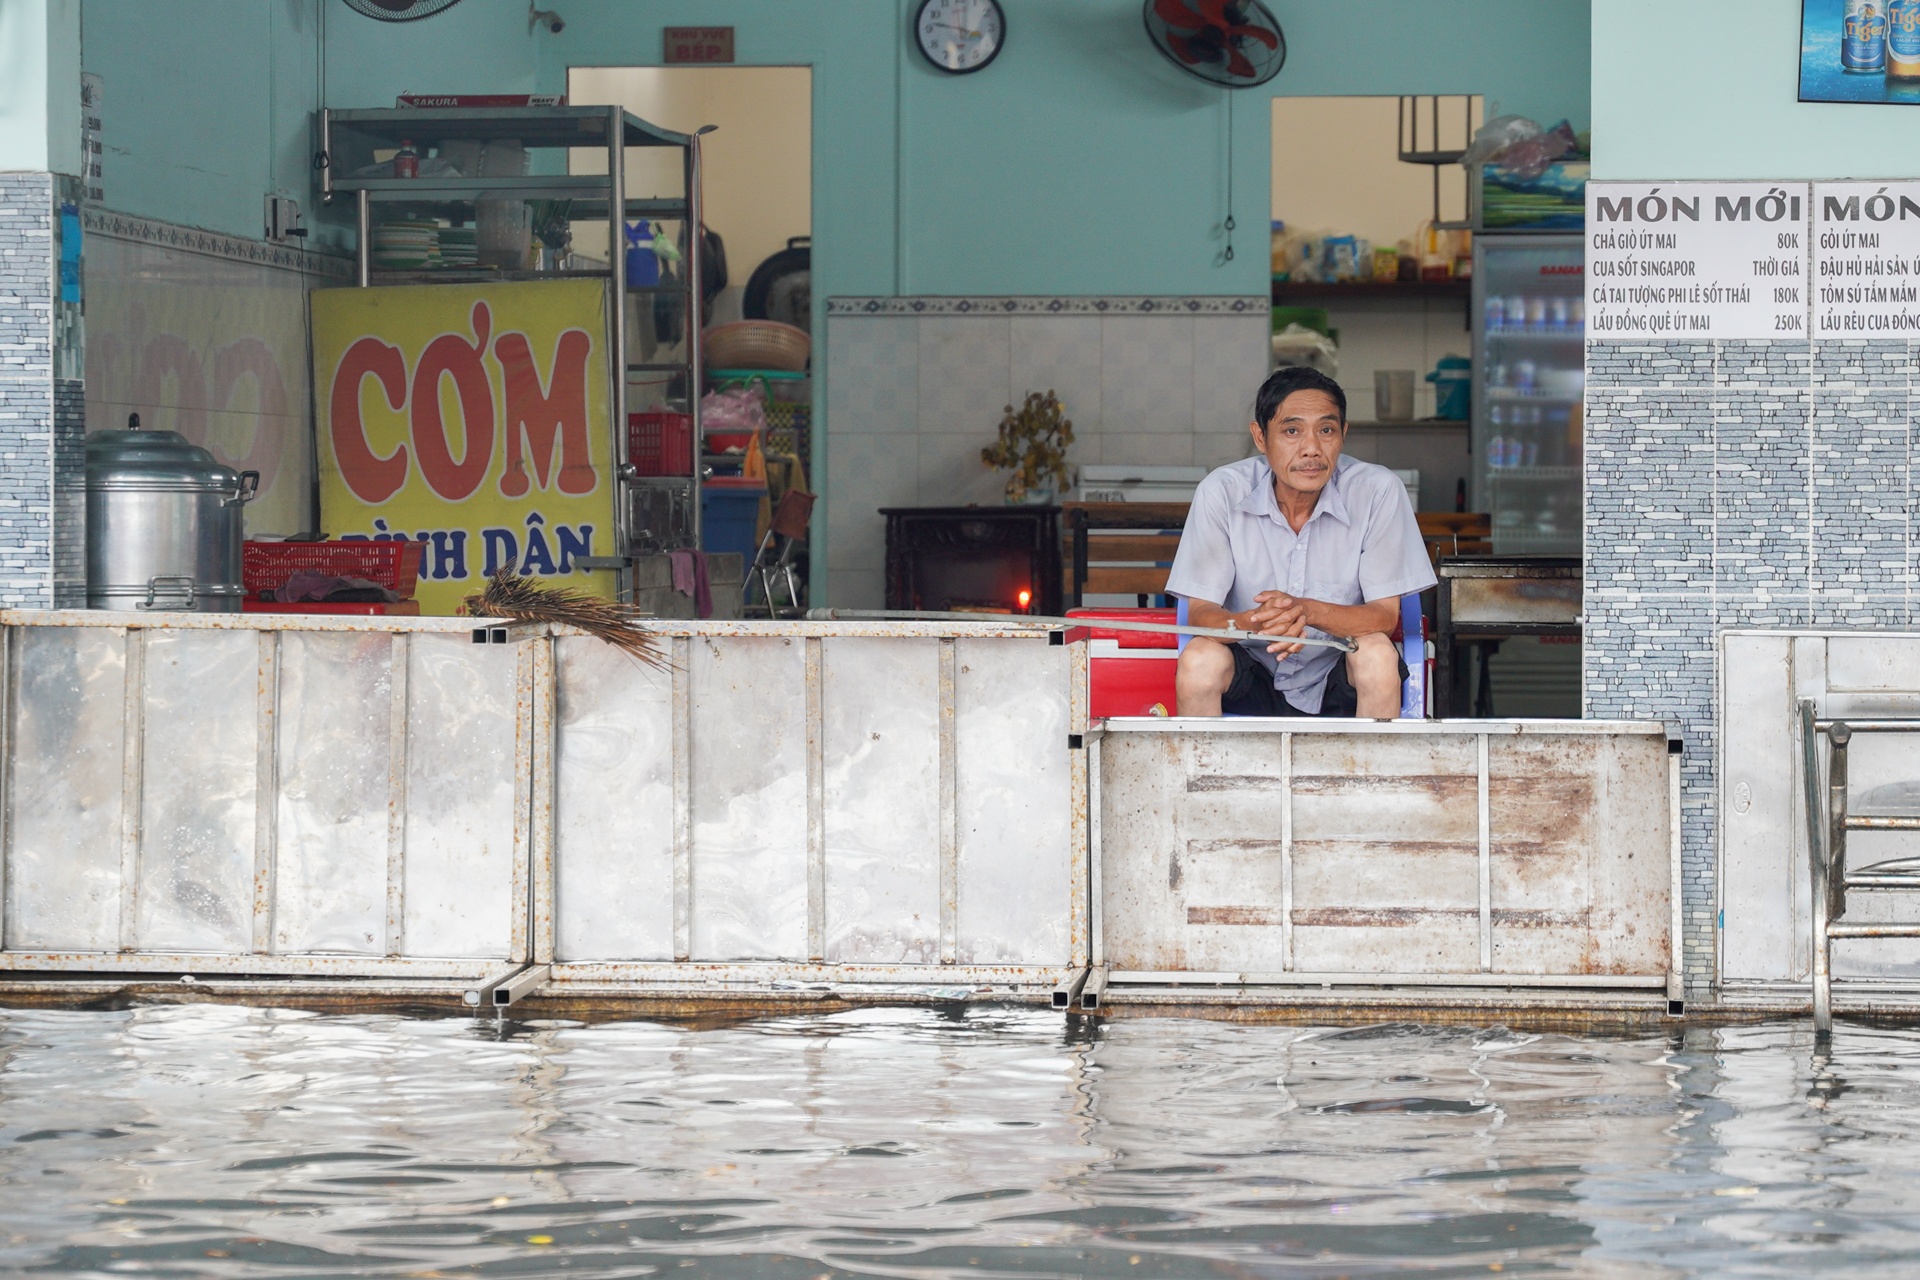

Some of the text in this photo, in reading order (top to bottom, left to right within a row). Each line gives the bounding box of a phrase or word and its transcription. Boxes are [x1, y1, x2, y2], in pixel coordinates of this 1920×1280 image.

[930, 10, 941, 19] 10
[1890, 8, 1920, 33] Tig
[925, 24, 933, 34] 9
[1847, 22, 1884, 42] Tiger
[413, 97, 458, 107] SAKURA
[1597, 188, 1800, 222] MÓN MỚI
[1824, 187, 1920, 222] MÓN
[1593, 228, 1799, 249] CHẢ GIÒ ÚT MAI 80K
[1821, 228, 1879, 249] GỎI ÚT MAI
[1593, 254, 1799, 276] CUA SỐT SINGAPOR THỜI GIÁ
[1820, 256, 1843, 280] ĐẬU
[1847, 255, 1862, 276] HỦ
[1865, 255, 1884, 276] HẢI
[1887, 255, 1908, 275] SẢN
[1593, 281, 1799, 308] CÁ TAI TƯỢNG PHI LÊ SỐT THÁI 180K
[1821, 280, 1917, 304] TÔM SÚ TẮM MẮM
[1593, 308, 1802, 334] LẨU ĐỒNG QUÊ ÚT MAI 250K
[1821, 308, 1920, 331] LẨU RÊU CUA ĐỒN
[331, 301, 597, 504] CƠM
[482, 512, 593, 578] DÂN
